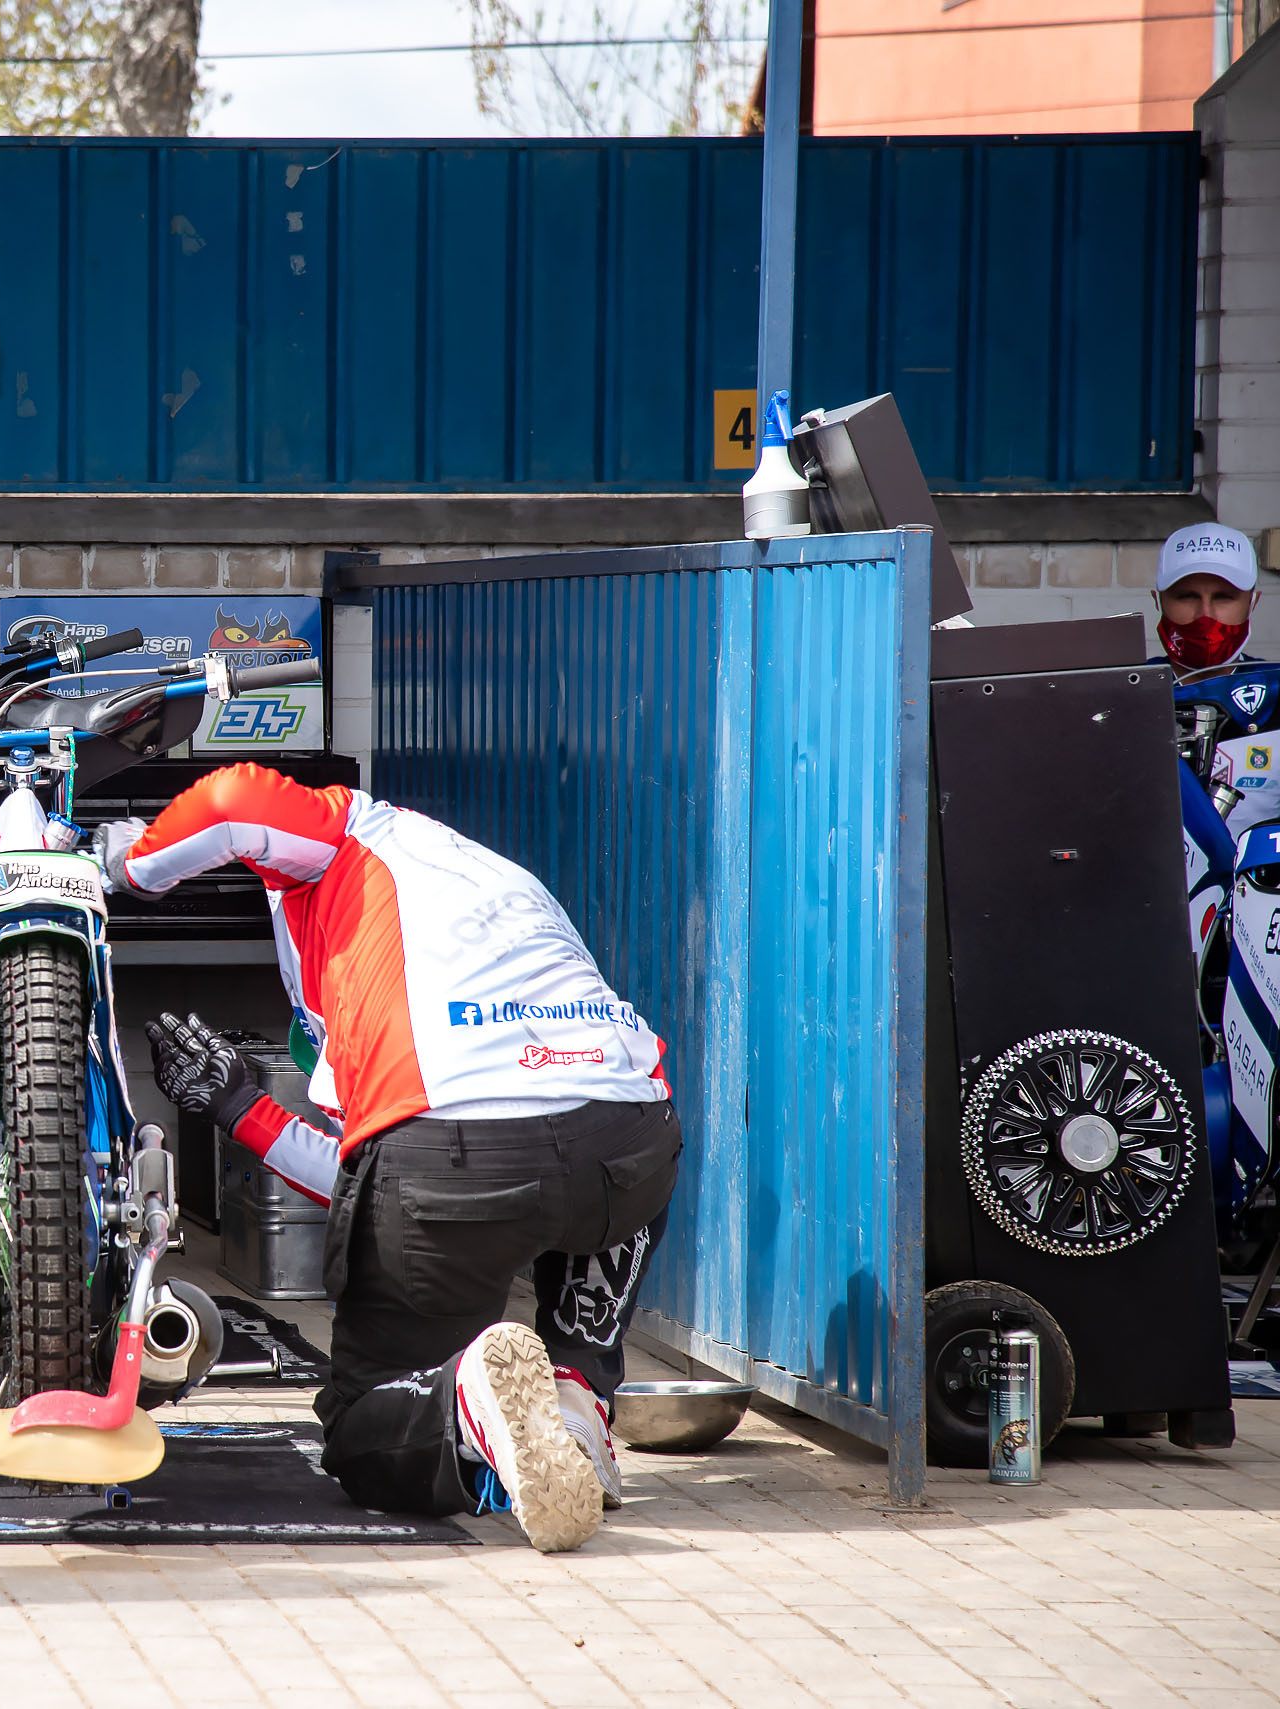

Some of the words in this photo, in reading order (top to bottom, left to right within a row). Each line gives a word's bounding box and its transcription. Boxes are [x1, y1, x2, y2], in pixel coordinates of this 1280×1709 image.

[728, 407, 755, 450] 4
[1176, 537, 1241, 552] SAGARI
[64, 624, 107, 637] Hans
[215, 701, 298, 737] 34
[6, 863, 40, 874] Hans
[17, 873, 97, 893] Andersen
[1227, 1020, 1269, 1101] SAGARI
[1008, 1374, 1026, 1382] Lube
[991, 1469, 1030, 1478] MAINTAIN
